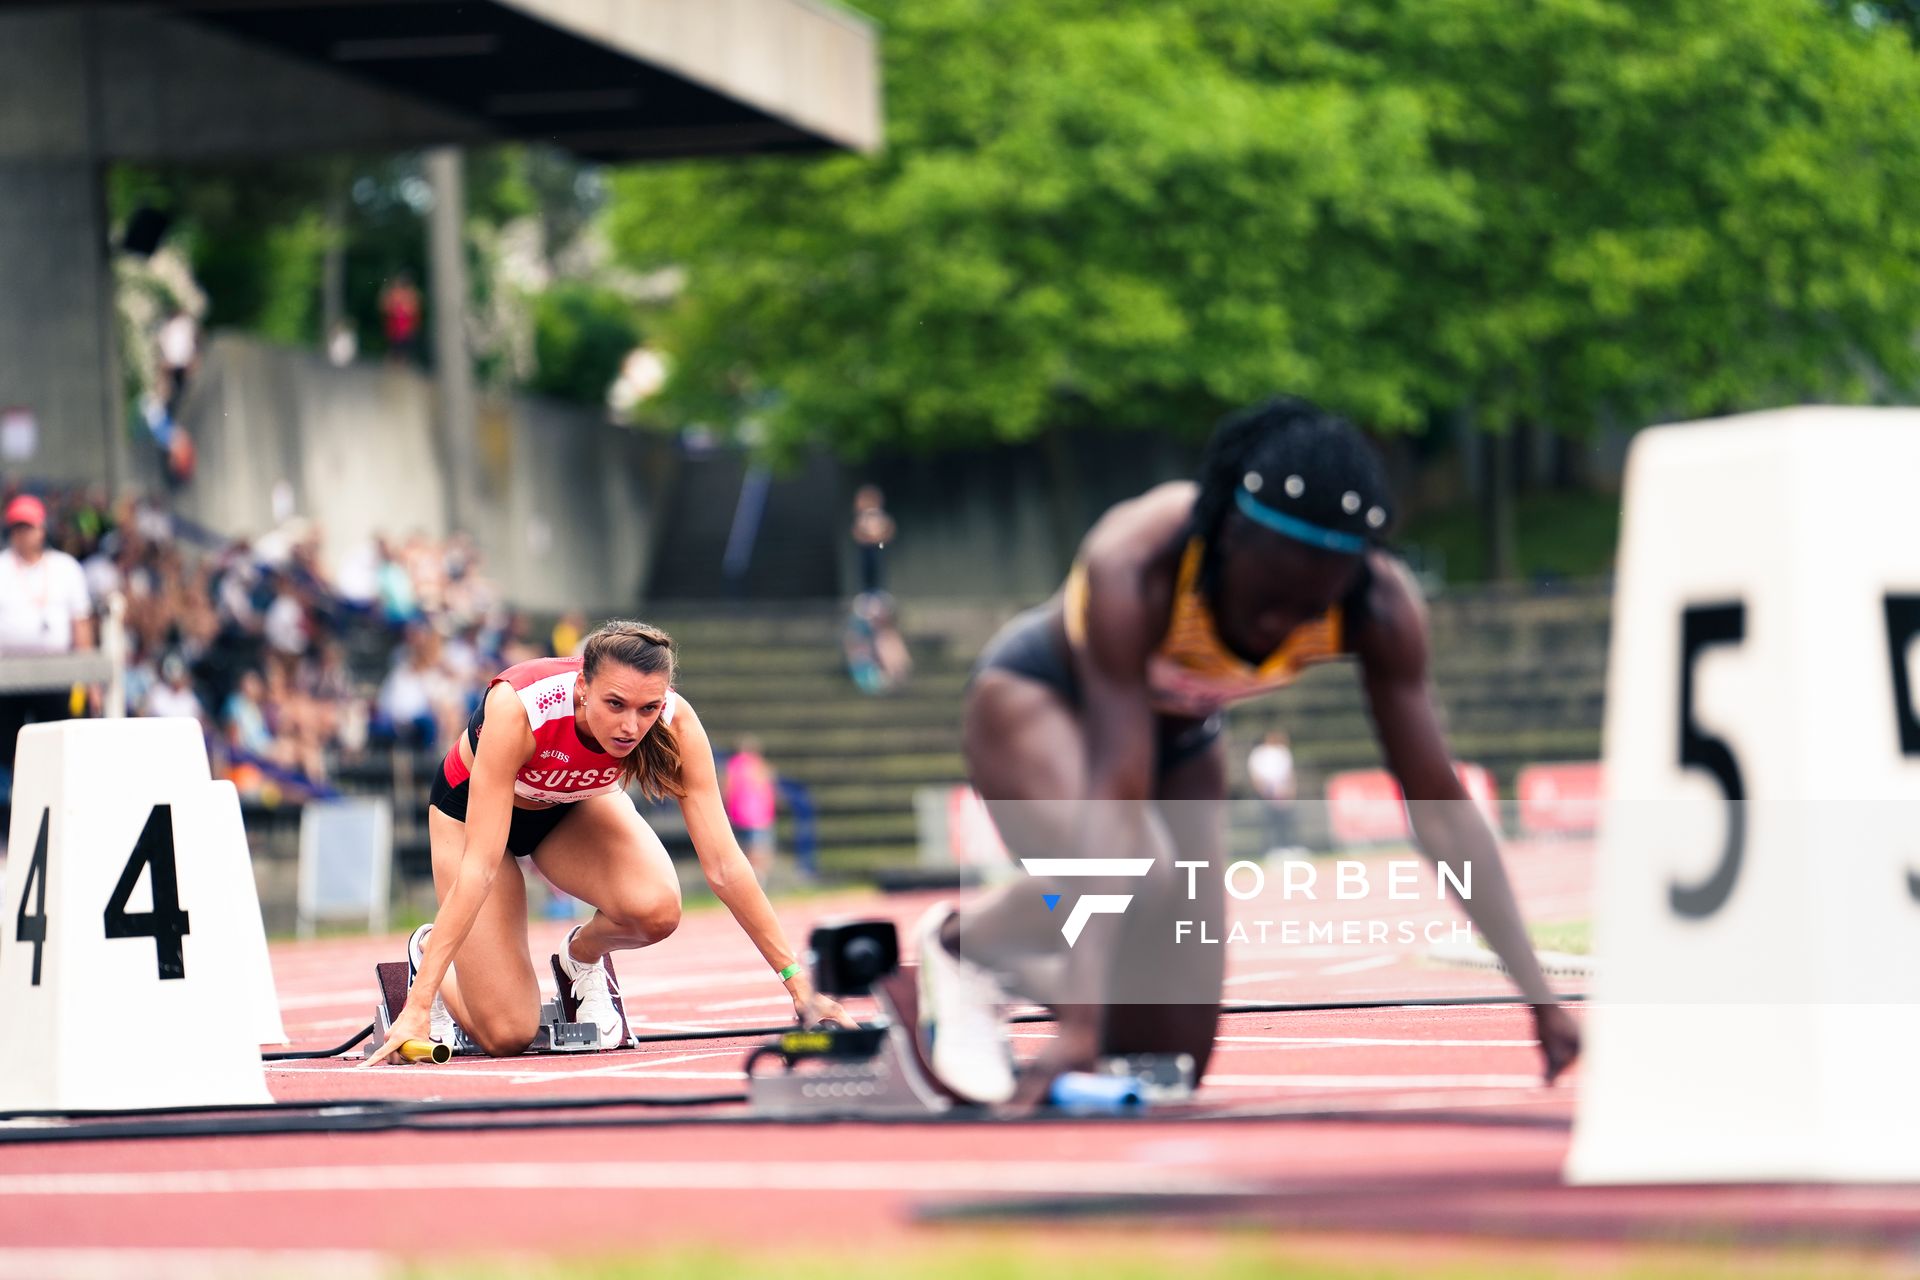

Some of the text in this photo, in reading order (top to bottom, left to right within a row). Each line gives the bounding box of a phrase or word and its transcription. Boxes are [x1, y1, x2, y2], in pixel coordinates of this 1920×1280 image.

[551, 749, 570, 763] UBS
[1668, 598, 1748, 921] 5
[16, 806, 50, 986] 4
[103, 804, 191, 980] 4
